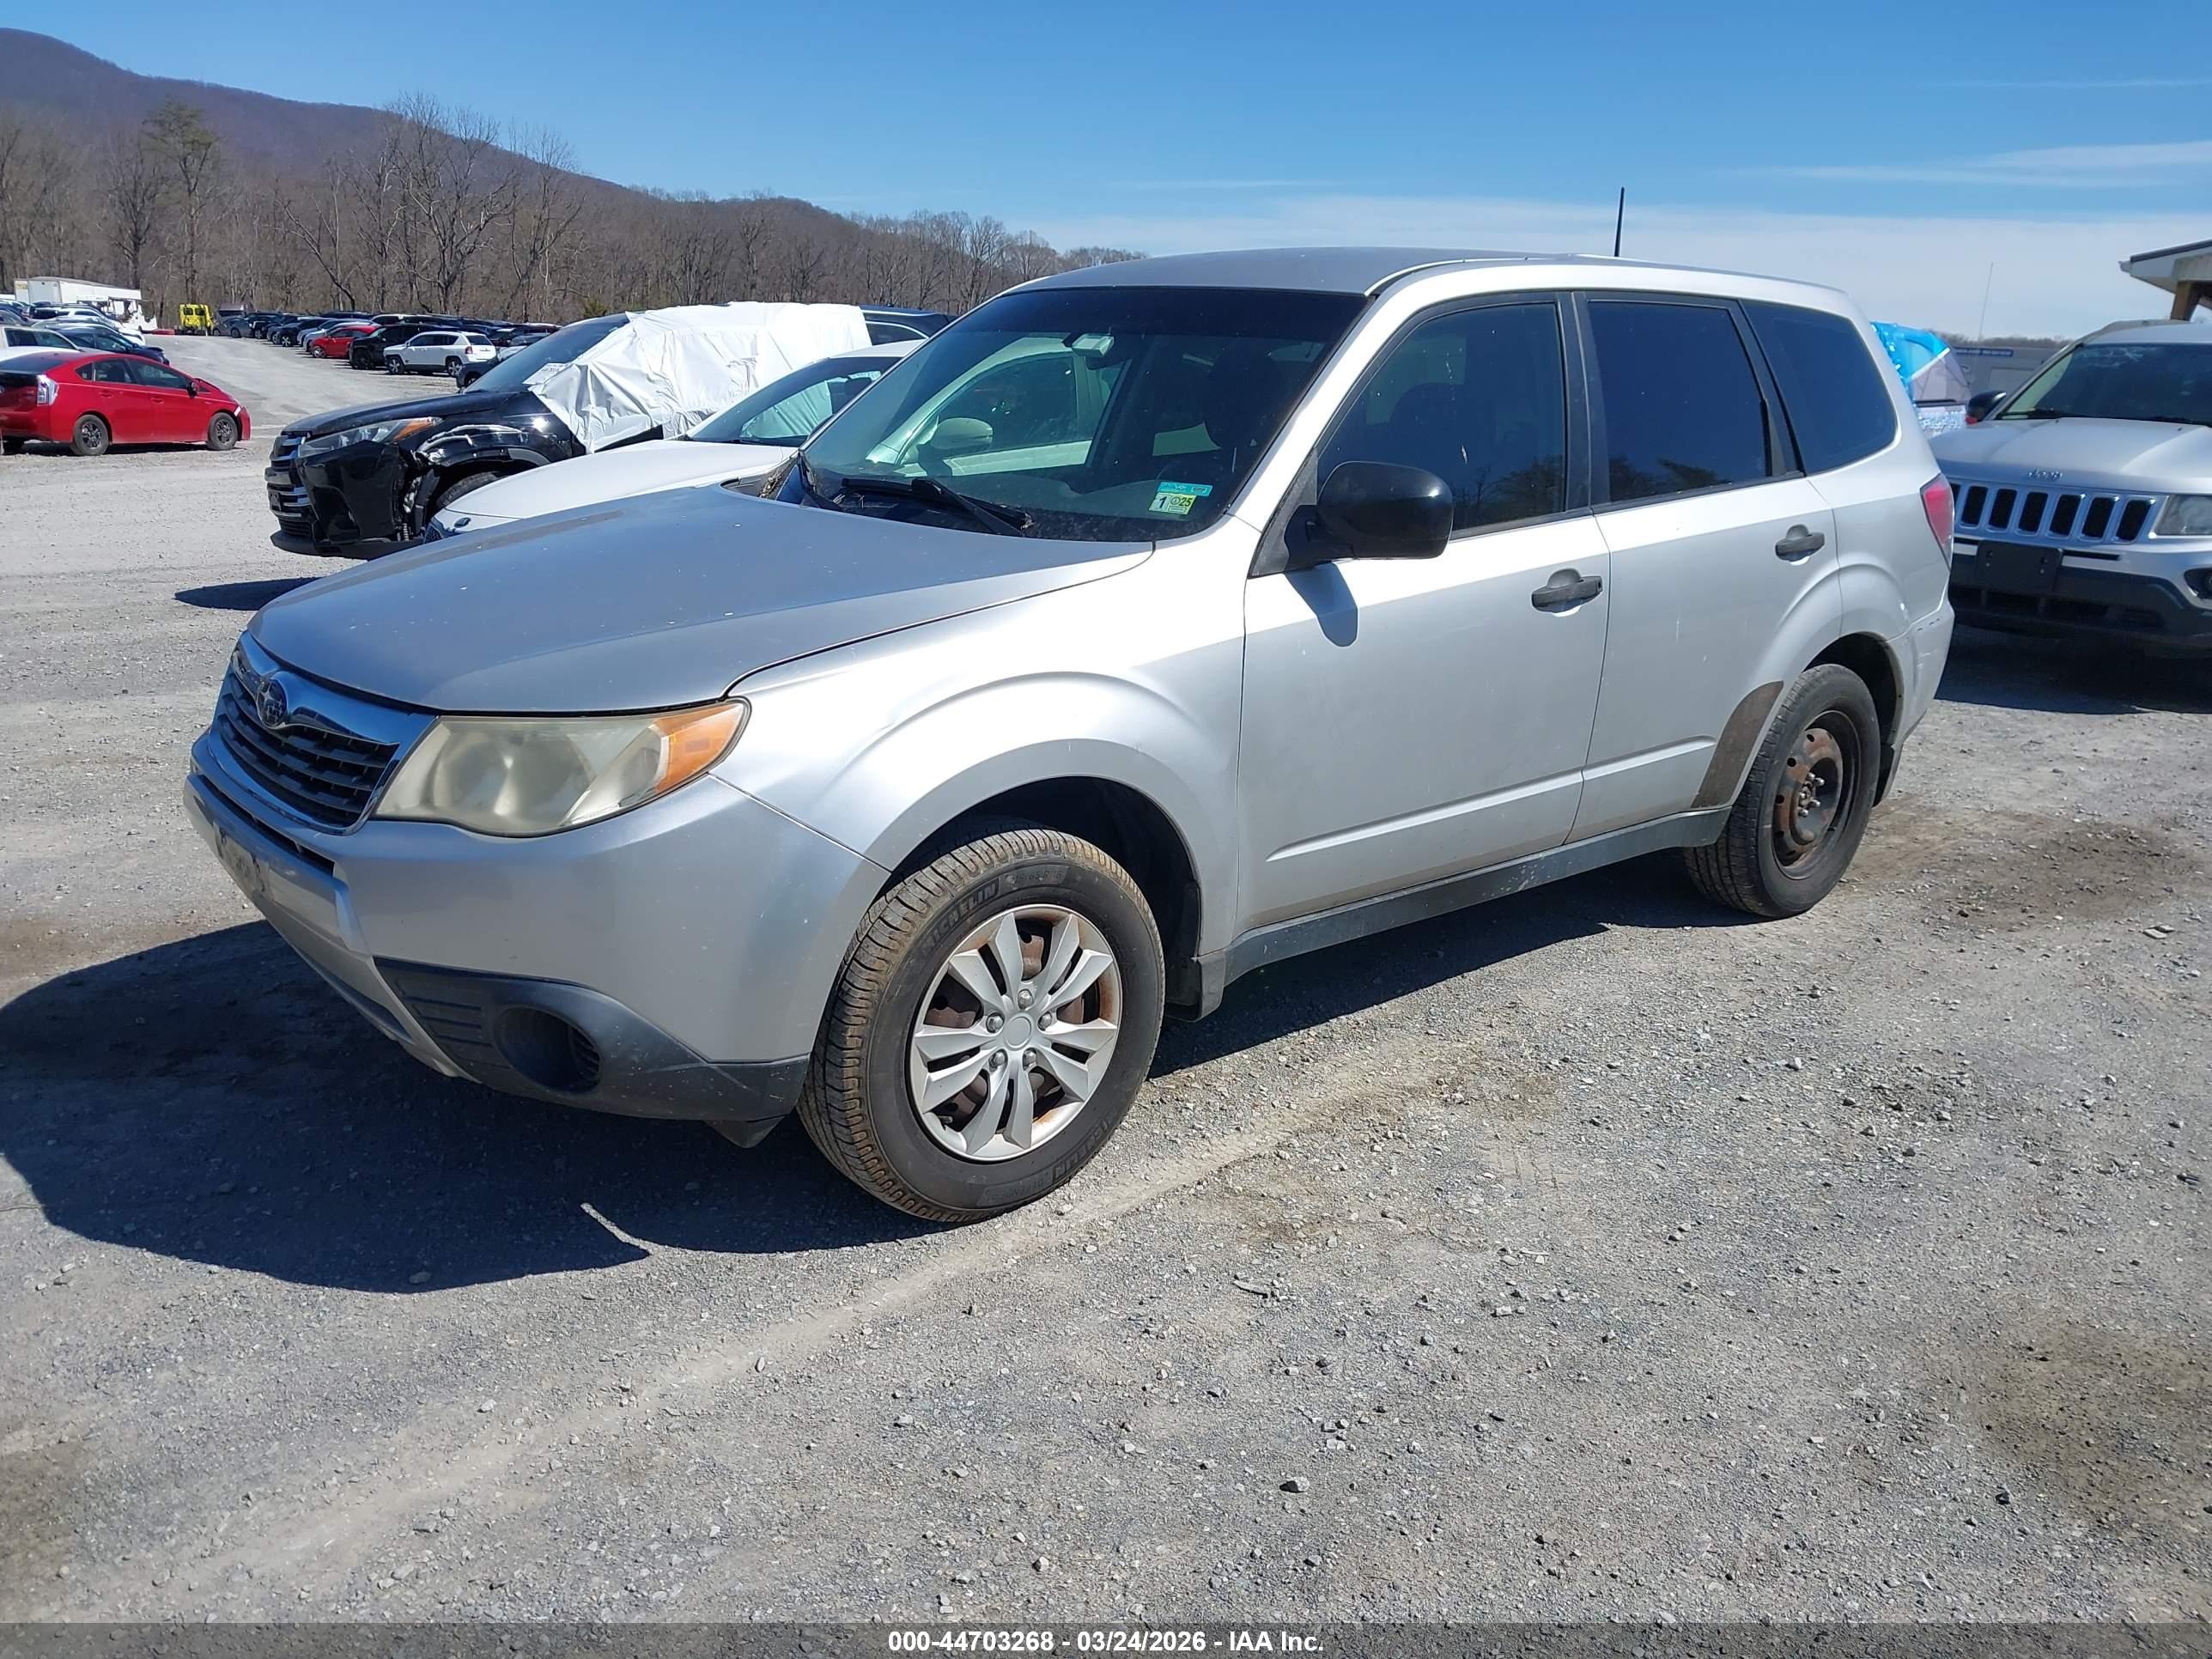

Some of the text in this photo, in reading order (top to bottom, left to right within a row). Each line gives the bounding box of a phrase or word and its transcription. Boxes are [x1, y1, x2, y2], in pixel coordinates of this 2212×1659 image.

[1159, 495, 1193, 509] 1 25
[921, 883, 997, 956] MICHELIN
